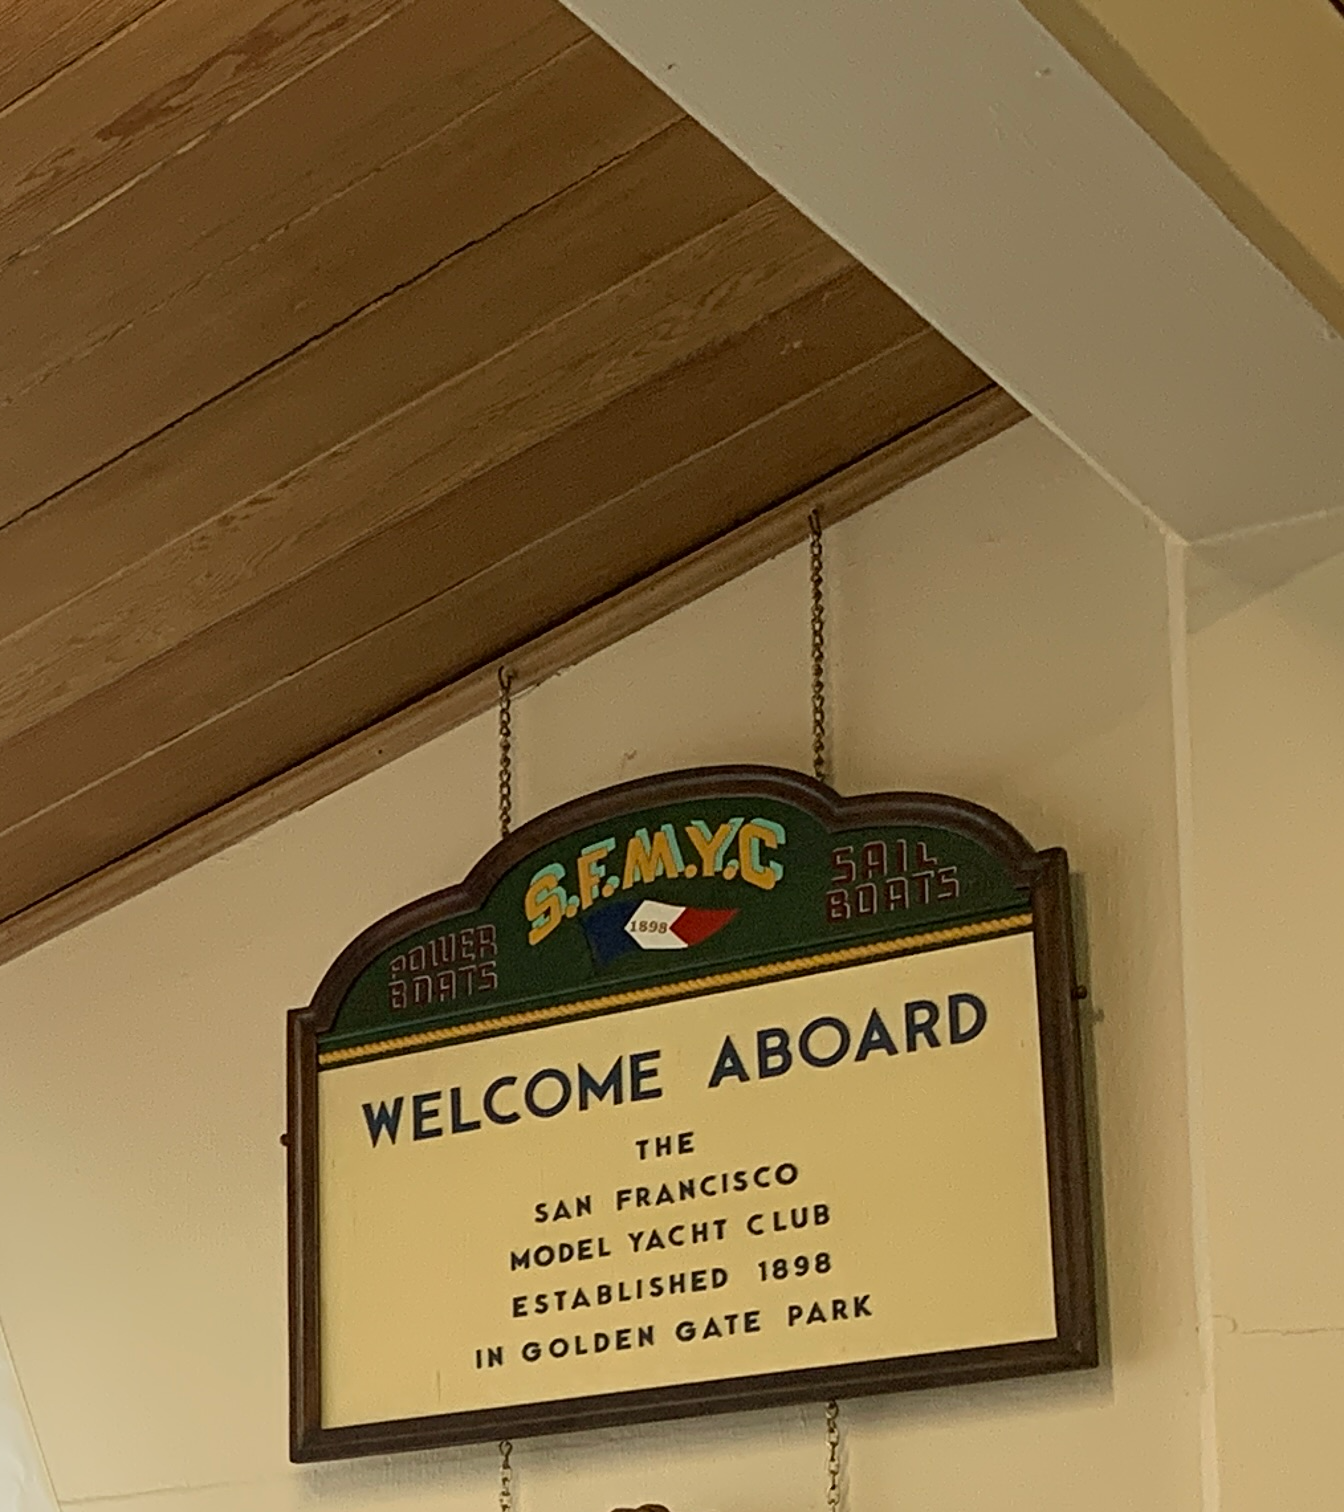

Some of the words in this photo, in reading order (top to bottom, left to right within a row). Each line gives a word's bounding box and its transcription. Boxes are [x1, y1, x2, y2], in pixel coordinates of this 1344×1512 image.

[830, 838, 938, 886] SAIL
[824, 865, 960, 925] BOATS
[389, 923, 498, 980] POWER
[628, 919, 669, 935] 1898
[388, 960, 498, 1010] BOATS
[362, 1049, 663, 1148] WELCOME
[707, 992, 988, 1089] ABOARD
[635, 1131, 695, 1161] THE
[534, 1194, 592, 1224] SAN
[616, 1162, 799, 1212] FRANCISCO
[510, 1237, 612, 1272] MODEL
[627, 1218, 727, 1253] YACHT
[746, 1203, 830, 1236] CLUB
[512, 1267, 728, 1319] ESTABLISHED
[758, 1252, 832, 1282] 1898
[475, 1346, 503, 1369] IN
[521, 1325, 654, 1363] GOLDEN
[675, 1310, 761, 1342] GATE
[788, 1294, 873, 1327] PARK
